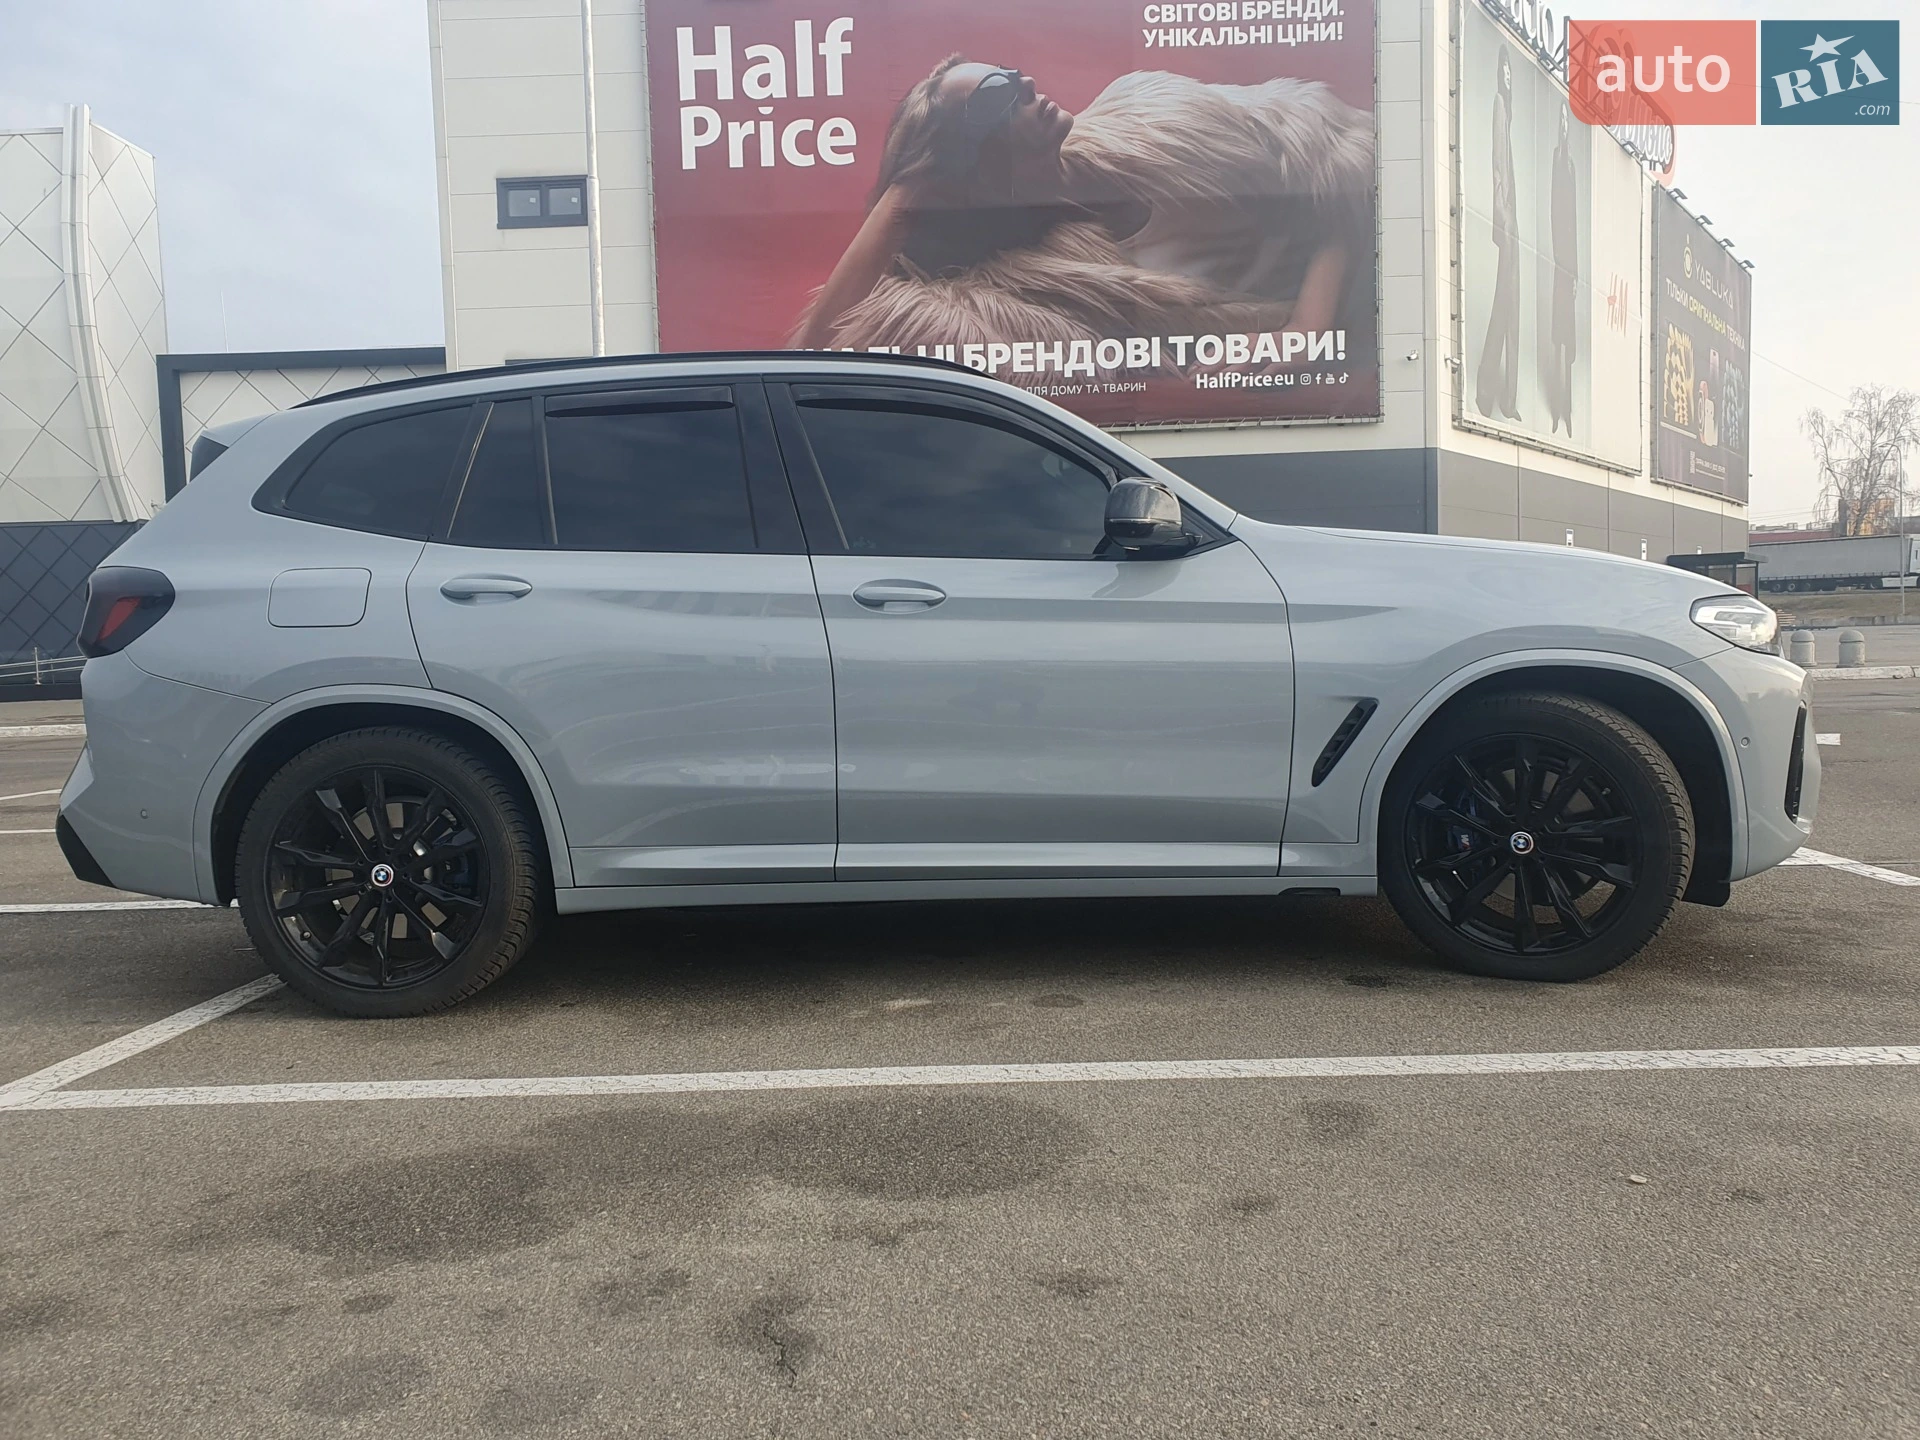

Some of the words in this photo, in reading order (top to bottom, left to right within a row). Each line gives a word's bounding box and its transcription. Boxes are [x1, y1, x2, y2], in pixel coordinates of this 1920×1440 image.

[1143, 2, 1238, 24] СВІТОВІ
[1242, 0, 1345, 22] БРЕНДИ.
[1142, 25, 1273, 48] УНІКАЛЬНІ
[1277, 22, 1344, 46] ЦІНИ!
[676, 17, 854, 101] Half
[680, 105, 857, 170] Price
[1695, 259, 1734, 310] YABLUKA
[963, 337, 1161, 379] БРЕНДОВІ
[1168, 330, 1347, 367] ТОВАРИ!
[1050, 384, 1083, 397] ДОМУ
[1085, 384, 1100, 394] ТА
[1102, 382, 1146, 393] ТВАРИН
[1196, 372, 1294, 389] HalfPrice.eu
